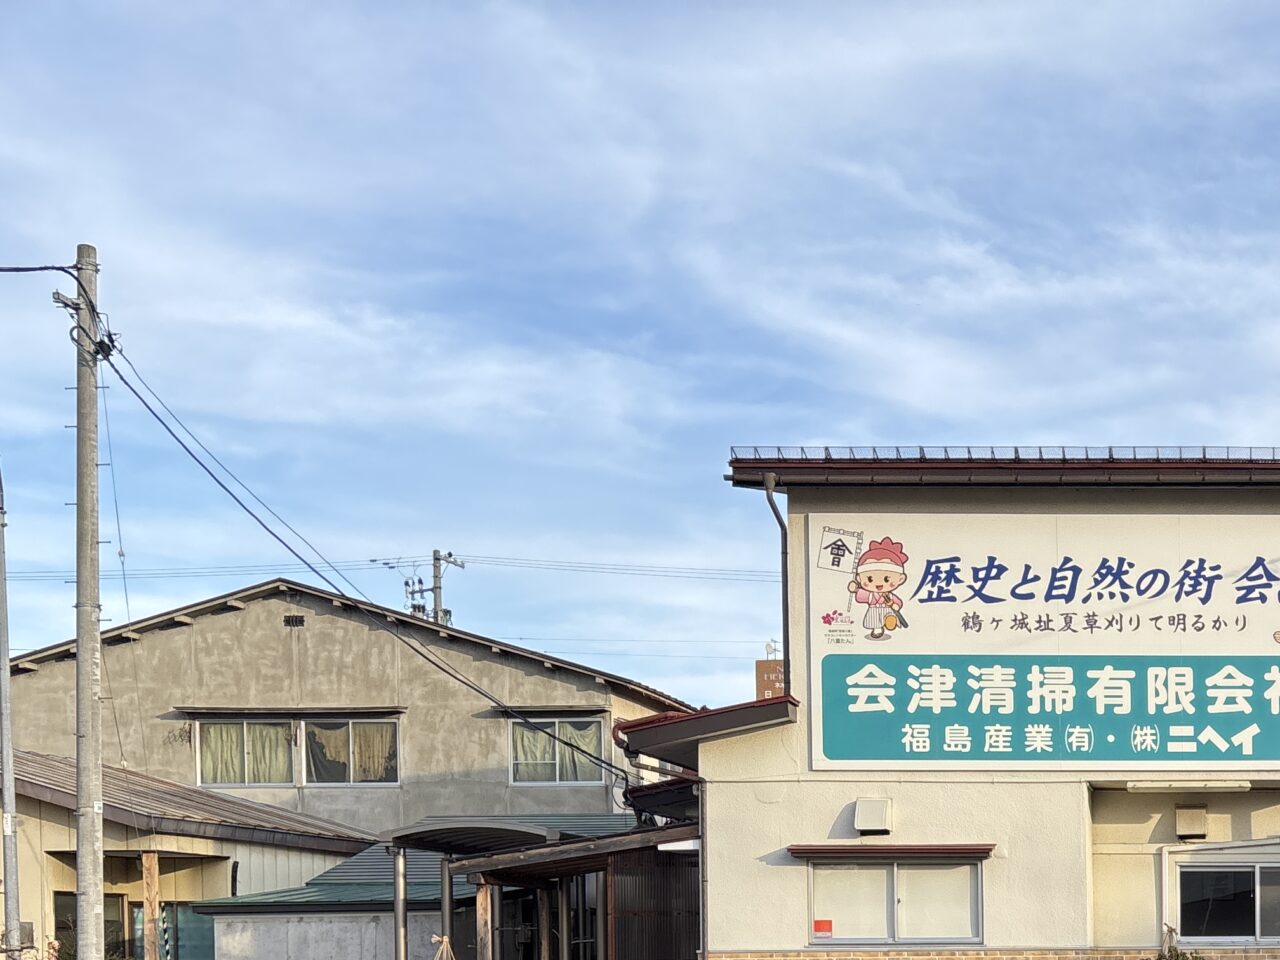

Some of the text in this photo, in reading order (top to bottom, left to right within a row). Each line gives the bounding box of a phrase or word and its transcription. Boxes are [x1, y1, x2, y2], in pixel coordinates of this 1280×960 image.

[910, 555, 1224, 605] 歴史と自然の街
